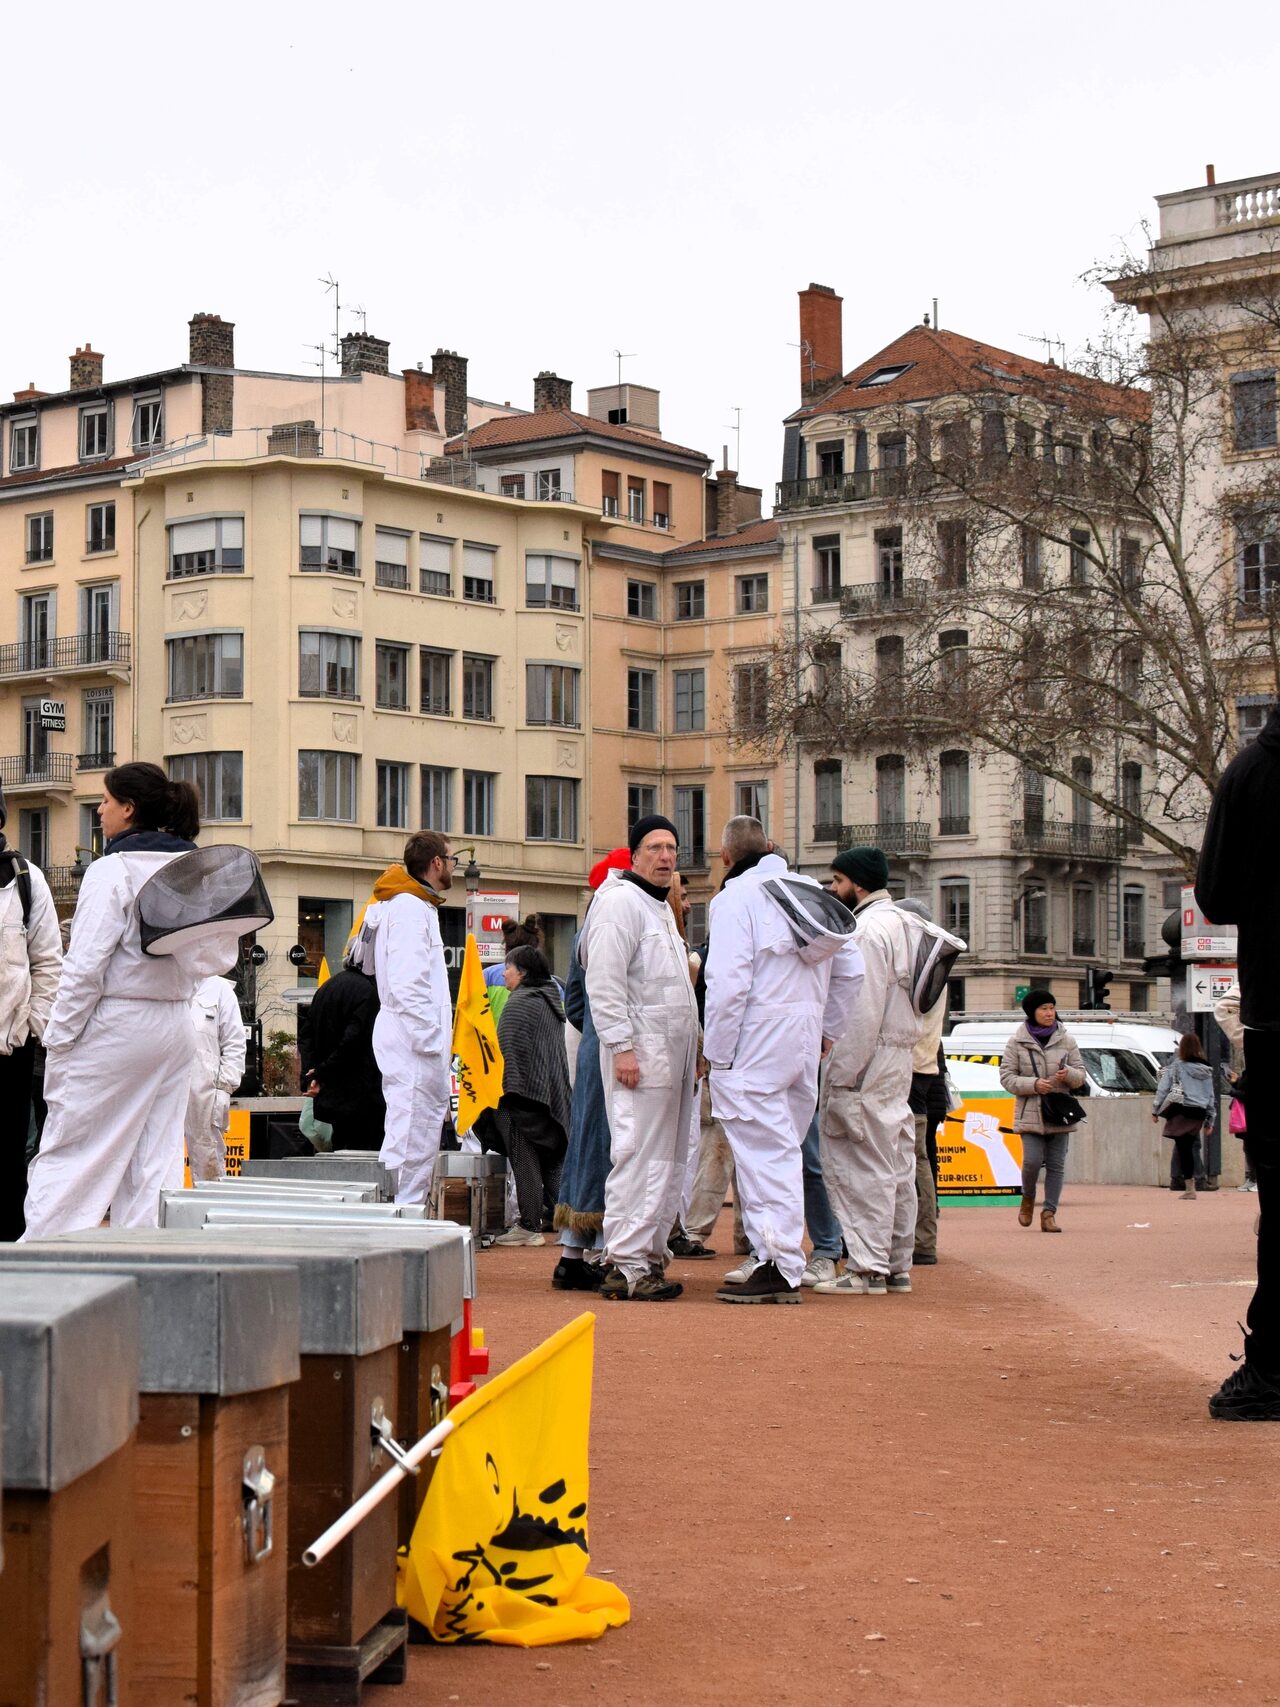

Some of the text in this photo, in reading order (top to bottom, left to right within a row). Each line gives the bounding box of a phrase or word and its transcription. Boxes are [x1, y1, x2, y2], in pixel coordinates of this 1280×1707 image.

[86, 688, 113, 698] LOISIRS
[42, 702, 65, 714] GYM
[41, 718, 65, 729] FITNESS
